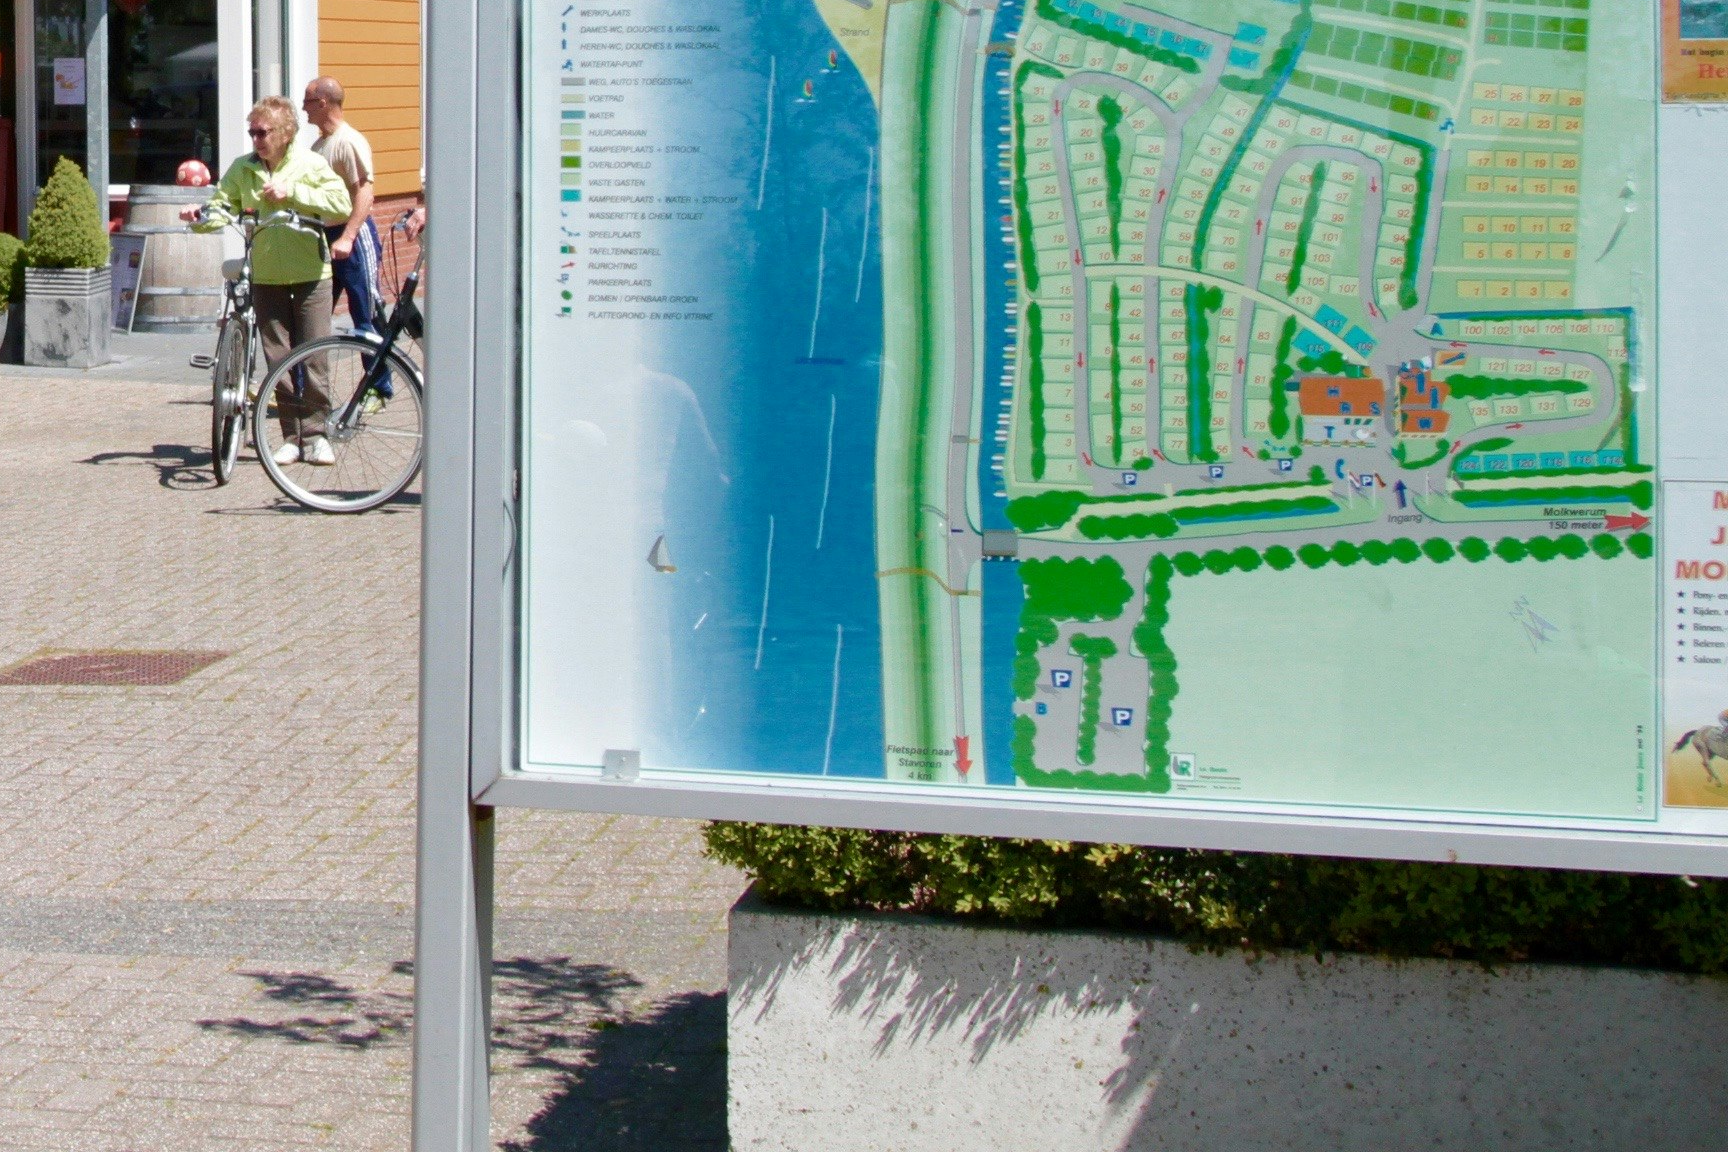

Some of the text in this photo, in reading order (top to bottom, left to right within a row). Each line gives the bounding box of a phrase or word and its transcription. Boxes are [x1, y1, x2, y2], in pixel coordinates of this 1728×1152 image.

[840, 27, 870, 37] Strand
[1058, 54, 1070, 62] 35
[1090, 58, 1103, 66] 37
[1116, 64, 1128, 72] 39
[1143, 75, 1154, 83] 41
[1166, 92, 1178, 100] 43
[1485, 90, 1498, 98] 25
[1510, 93, 1522, 101] 26
[1539, 94, 1551, 102] 27
[1235, 109, 1248, 117] 47
[1278, 120, 1290, 128] 80
[1481, 116, 1493, 124] 21
[1507, 118, 1520, 126] 22
[1537, 120, 1550, 128] 23
[1081, 129, 1093, 137] 20
[1310, 127, 1323, 136] 82
[1037, 138, 1048, 146] 27
[1478, 158, 1490, 166] 17
[1505, 158, 1517, 166] 18
[1342, 172, 1354, 181] 95
[1045, 186, 1056, 194] 23
[676, 212, 704, 220] TOILET
[1134, 210, 1146, 218] 34
[1229, 210, 1240, 218] 72
[1397, 210, 1410, 218] 92
[1503, 224, 1515, 232] 10
[1560, 223, 1571, 231] 12
[1323, 233, 1339, 241] 101
[1394, 234, 1406, 242] 94
[1130, 254, 1142, 262] 38
[1313, 254, 1330, 262] 103
[1339, 284, 1356, 292] 107
[1383, 284, 1395, 292] 98
[1530, 287, 1537, 296] 3
[1464, 326, 1482, 335] 100
[1518, 326, 1536, 334] 104
[1258, 332, 1270, 340] 83
[1514, 363, 1531, 372] 123
[1572, 370, 1590, 379] 127
[1538, 402, 1555, 411] 131
[1172, 418, 1184, 426] 75
[1131, 426, 1143, 435] 52
[1324, 426, 1335, 438] T
[1543, 507, 1606, 516] Molkwerum
[1388, 514, 1422, 524] Ingang
[1549, 521, 1603, 530] 150 meter
[1693, 655, 1721, 663] Saloon
[1035, 702, 1048, 716] B
[886, 744, 954, 756] Fietspad naar
[898, 758, 942, 768] Stavoren
[918, 771, 932, 780] km
